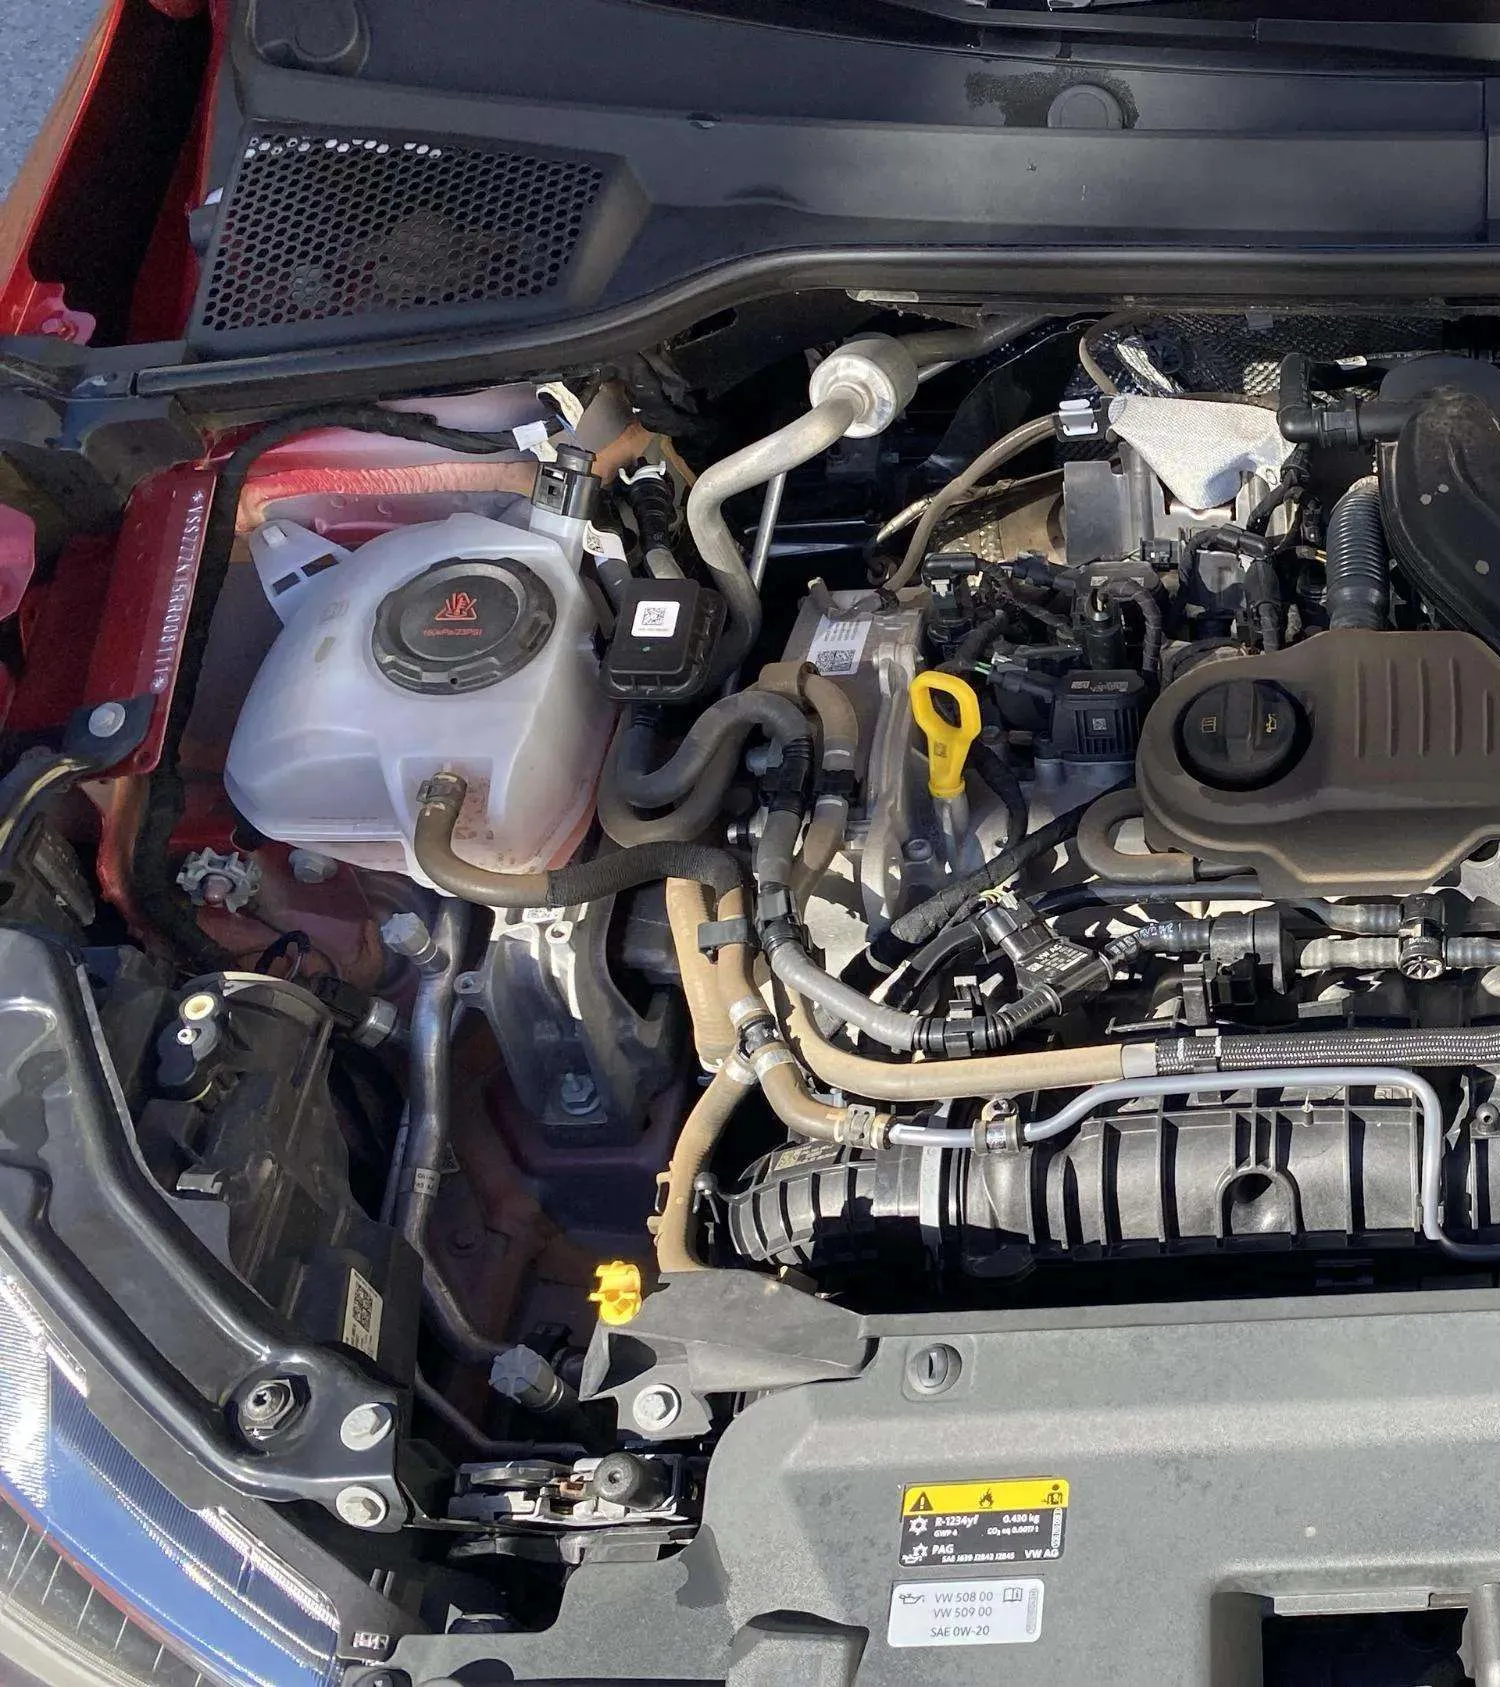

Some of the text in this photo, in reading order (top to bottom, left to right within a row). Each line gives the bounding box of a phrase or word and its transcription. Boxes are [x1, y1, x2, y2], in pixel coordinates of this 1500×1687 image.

[1035, 944, 1063, 960] VW AG
[934, 1514, 979, 1529] R-1234yf
[1028, 1513, 1041, 1525] kg
[934, 1530, 951, 1538] GWP
[931, 1544, 955, 1556] PAG
[1024, 1548, 1060, 1559] VW AG
[941, 1554, 956, 1564] SAE
[934, 1590, 994, 1603] VW 508 00
[933, 1606, 993, 1619] VW 509 00
[930, 1625, 990, 1638] SAE 0W-20
